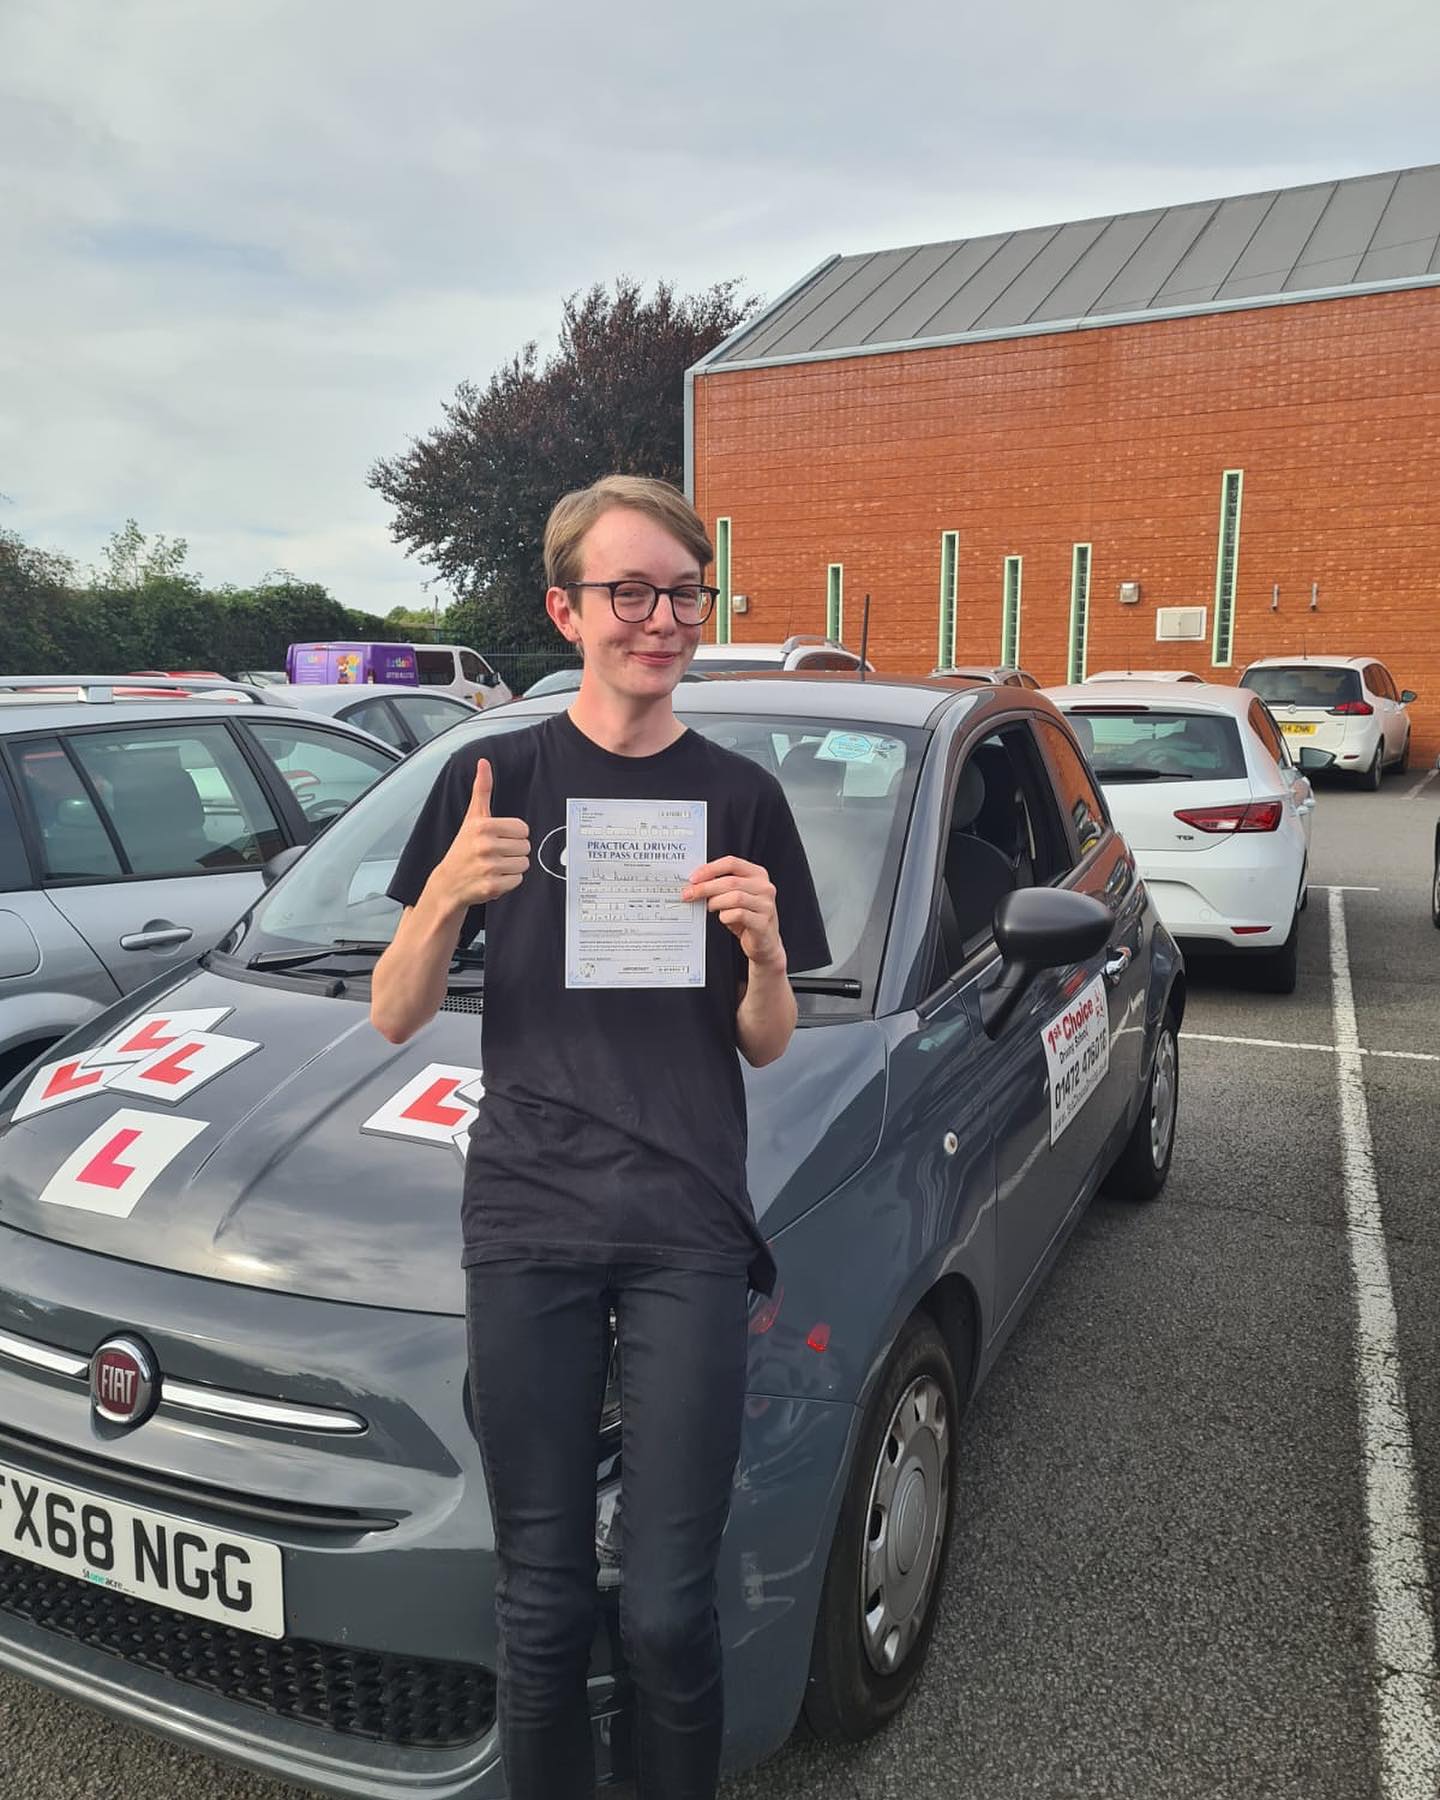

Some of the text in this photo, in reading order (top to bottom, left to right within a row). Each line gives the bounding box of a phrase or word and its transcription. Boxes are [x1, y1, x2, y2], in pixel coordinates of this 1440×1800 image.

[587, 841, 687, 851] PRACTICAL DRIVING
[588, 850, 686, 860] TEST PASS CERTIFICATE
[117, 1020, 178, 1053] L
[1048, 999, 1094, 1053] 1st Choice
[41, 1062, 103, 1100] L
[139, 1043, 205, 1085] L
[1055, 1060, 1080, 1110] 01472
[400, 1078, 468, 1126] L
[75, 1128, 143, 1189] L
[102, 1364, 136, 1405] FIAT
[133, 1518, 253, 1613] NGG
